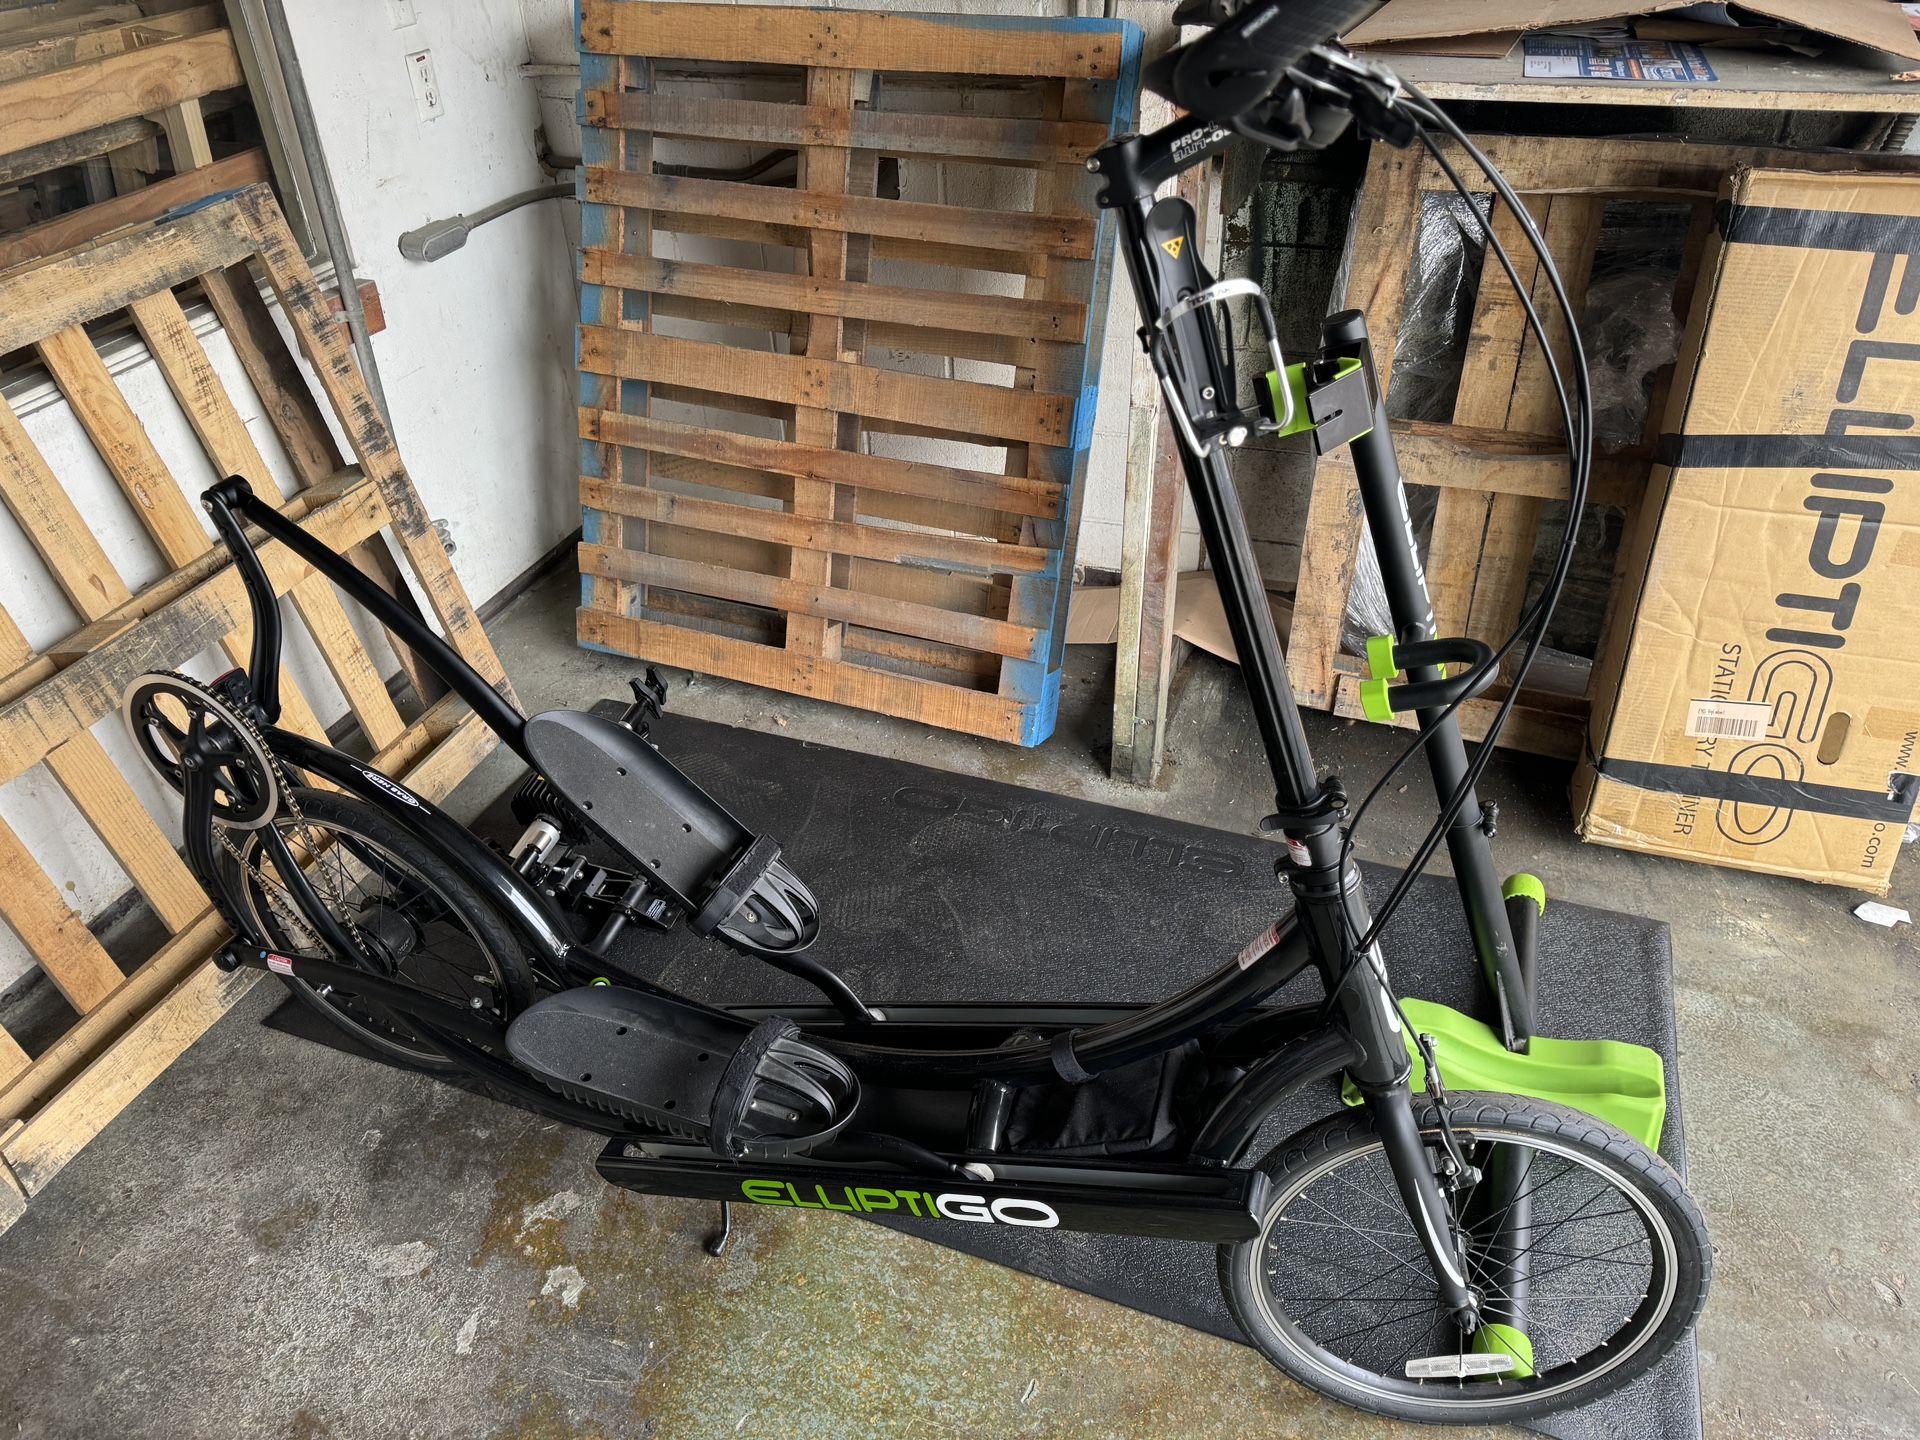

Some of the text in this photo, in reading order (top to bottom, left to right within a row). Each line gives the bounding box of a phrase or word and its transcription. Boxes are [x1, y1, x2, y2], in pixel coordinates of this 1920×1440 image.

[1170, 120, 1220, 152] PRO-L
[1695, 642, 1742, 761] STATIRY
[367, 773, 416, 805] GRAB HERE
[1673, 763, 1710, 835] TINER
[741, 1178, 1060, 1228] ELLIPTIGO
